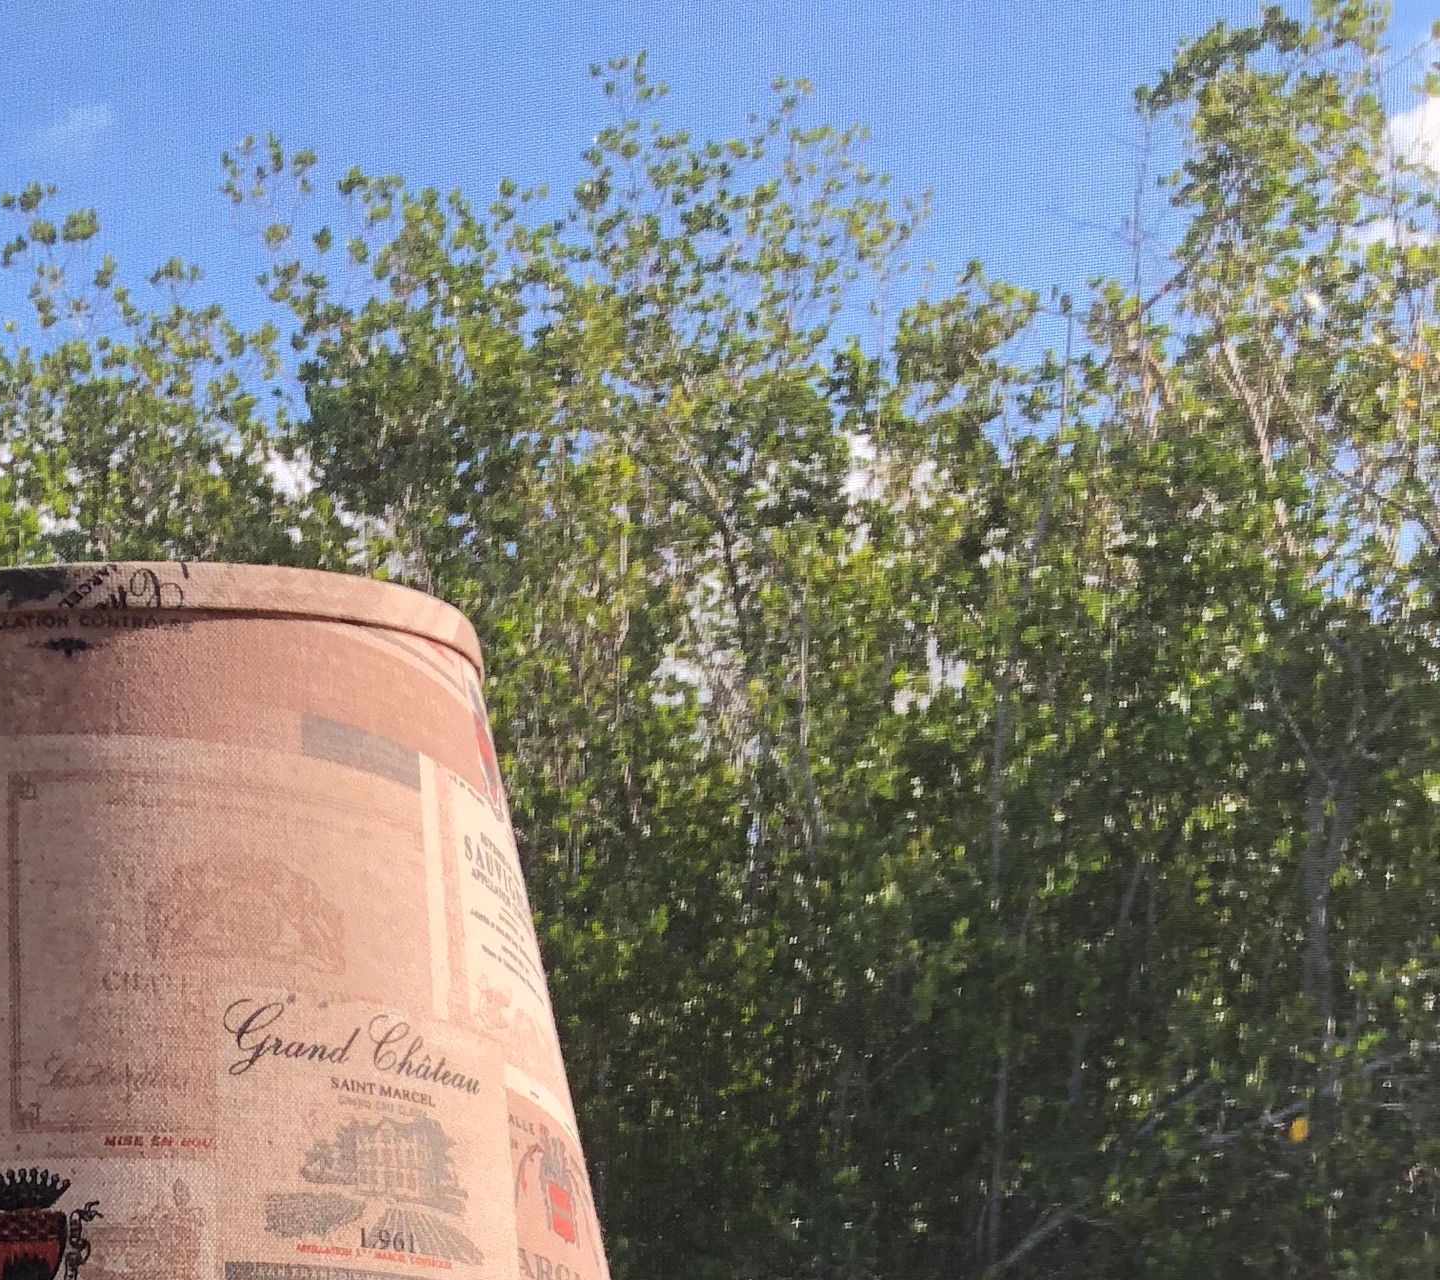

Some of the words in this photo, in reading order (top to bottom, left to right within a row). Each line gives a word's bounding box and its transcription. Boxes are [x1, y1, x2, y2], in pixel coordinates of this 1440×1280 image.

[224, 998, 361, 1076] Grand
[368, 1014, 481, 1095] Château
[330, 1076, 377, 1096] SAINT
[379, 1086, 437, 1108] MARCEL
